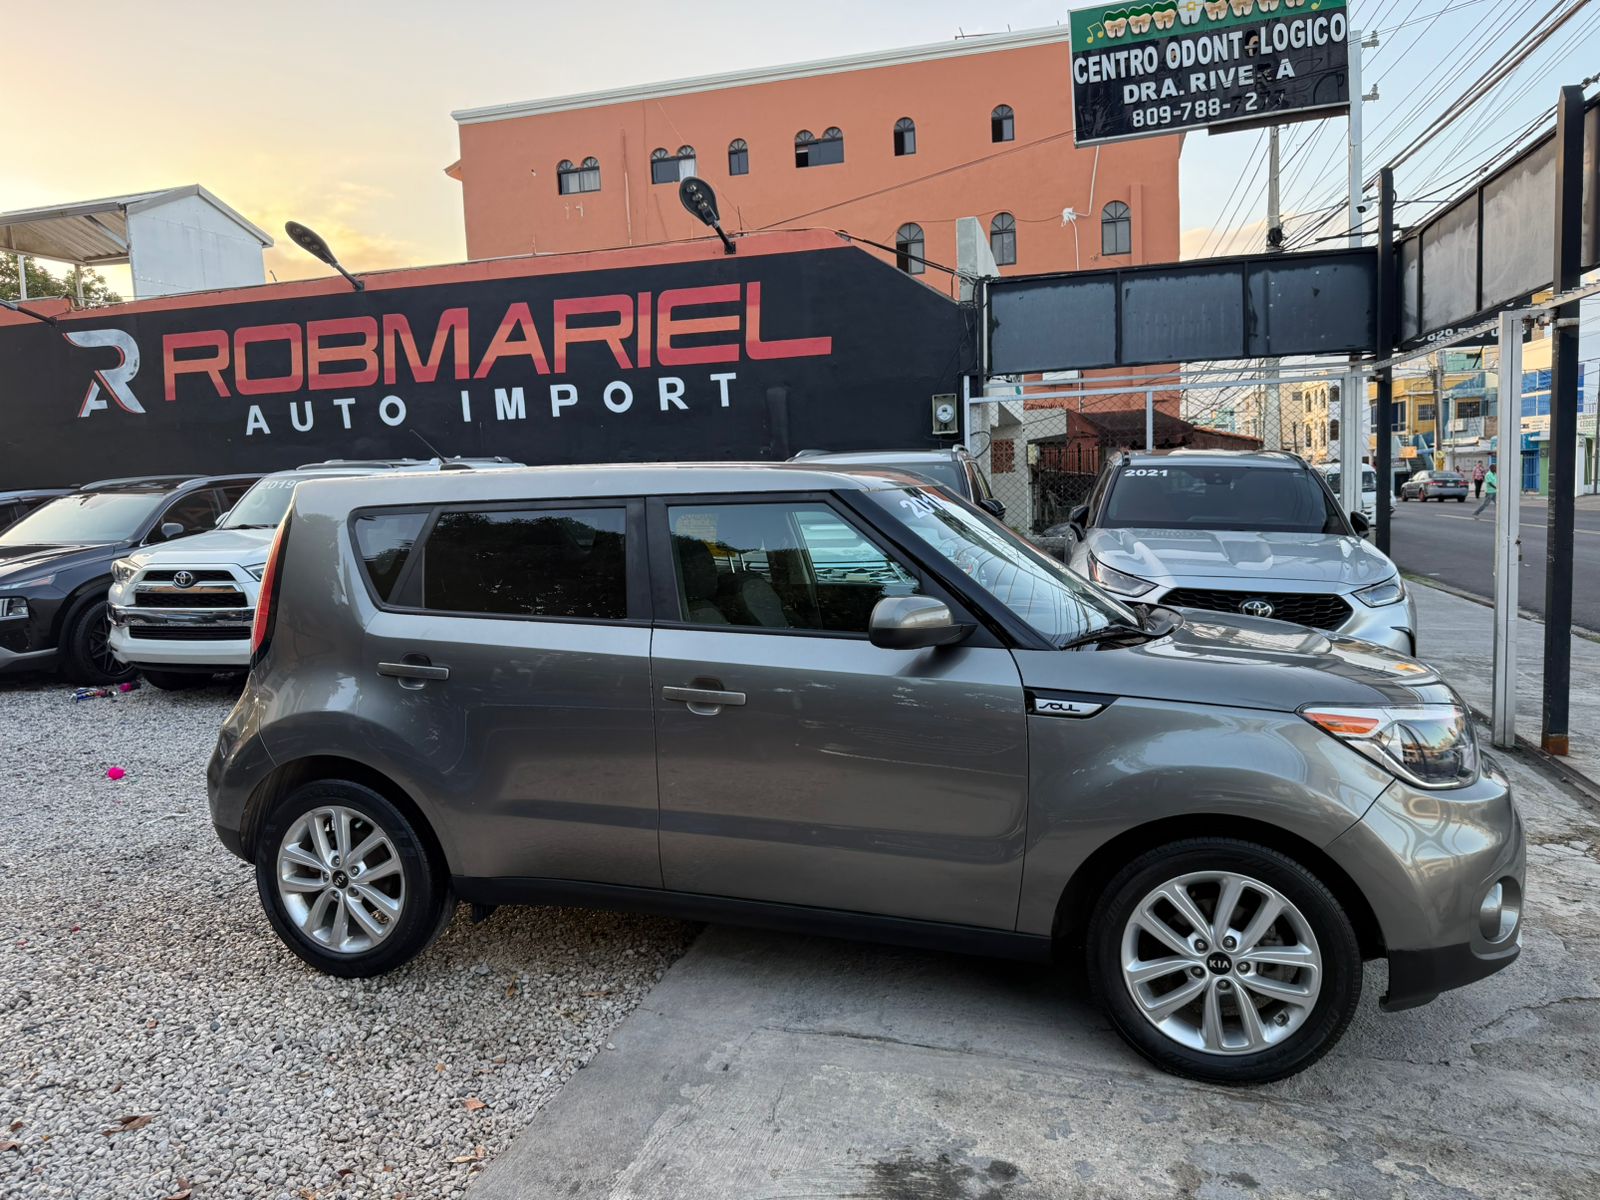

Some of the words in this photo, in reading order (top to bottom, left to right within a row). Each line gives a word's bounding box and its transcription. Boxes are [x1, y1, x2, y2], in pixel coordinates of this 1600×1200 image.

[1073, 45, 1158, 84] CENTRO
[1166, 12, 1347, 70] ODONTLOGICO
[1123, 78, 1185, 104] DRA.
[162, 282, 833, 401] ROBMARIEL
[246, 395, 407, 436] AUTO
[461, 372, 737, 423] IMPORT
[1124, 469, 1169, 477] 2021
[1209, 959, 1230, 969] KIA
